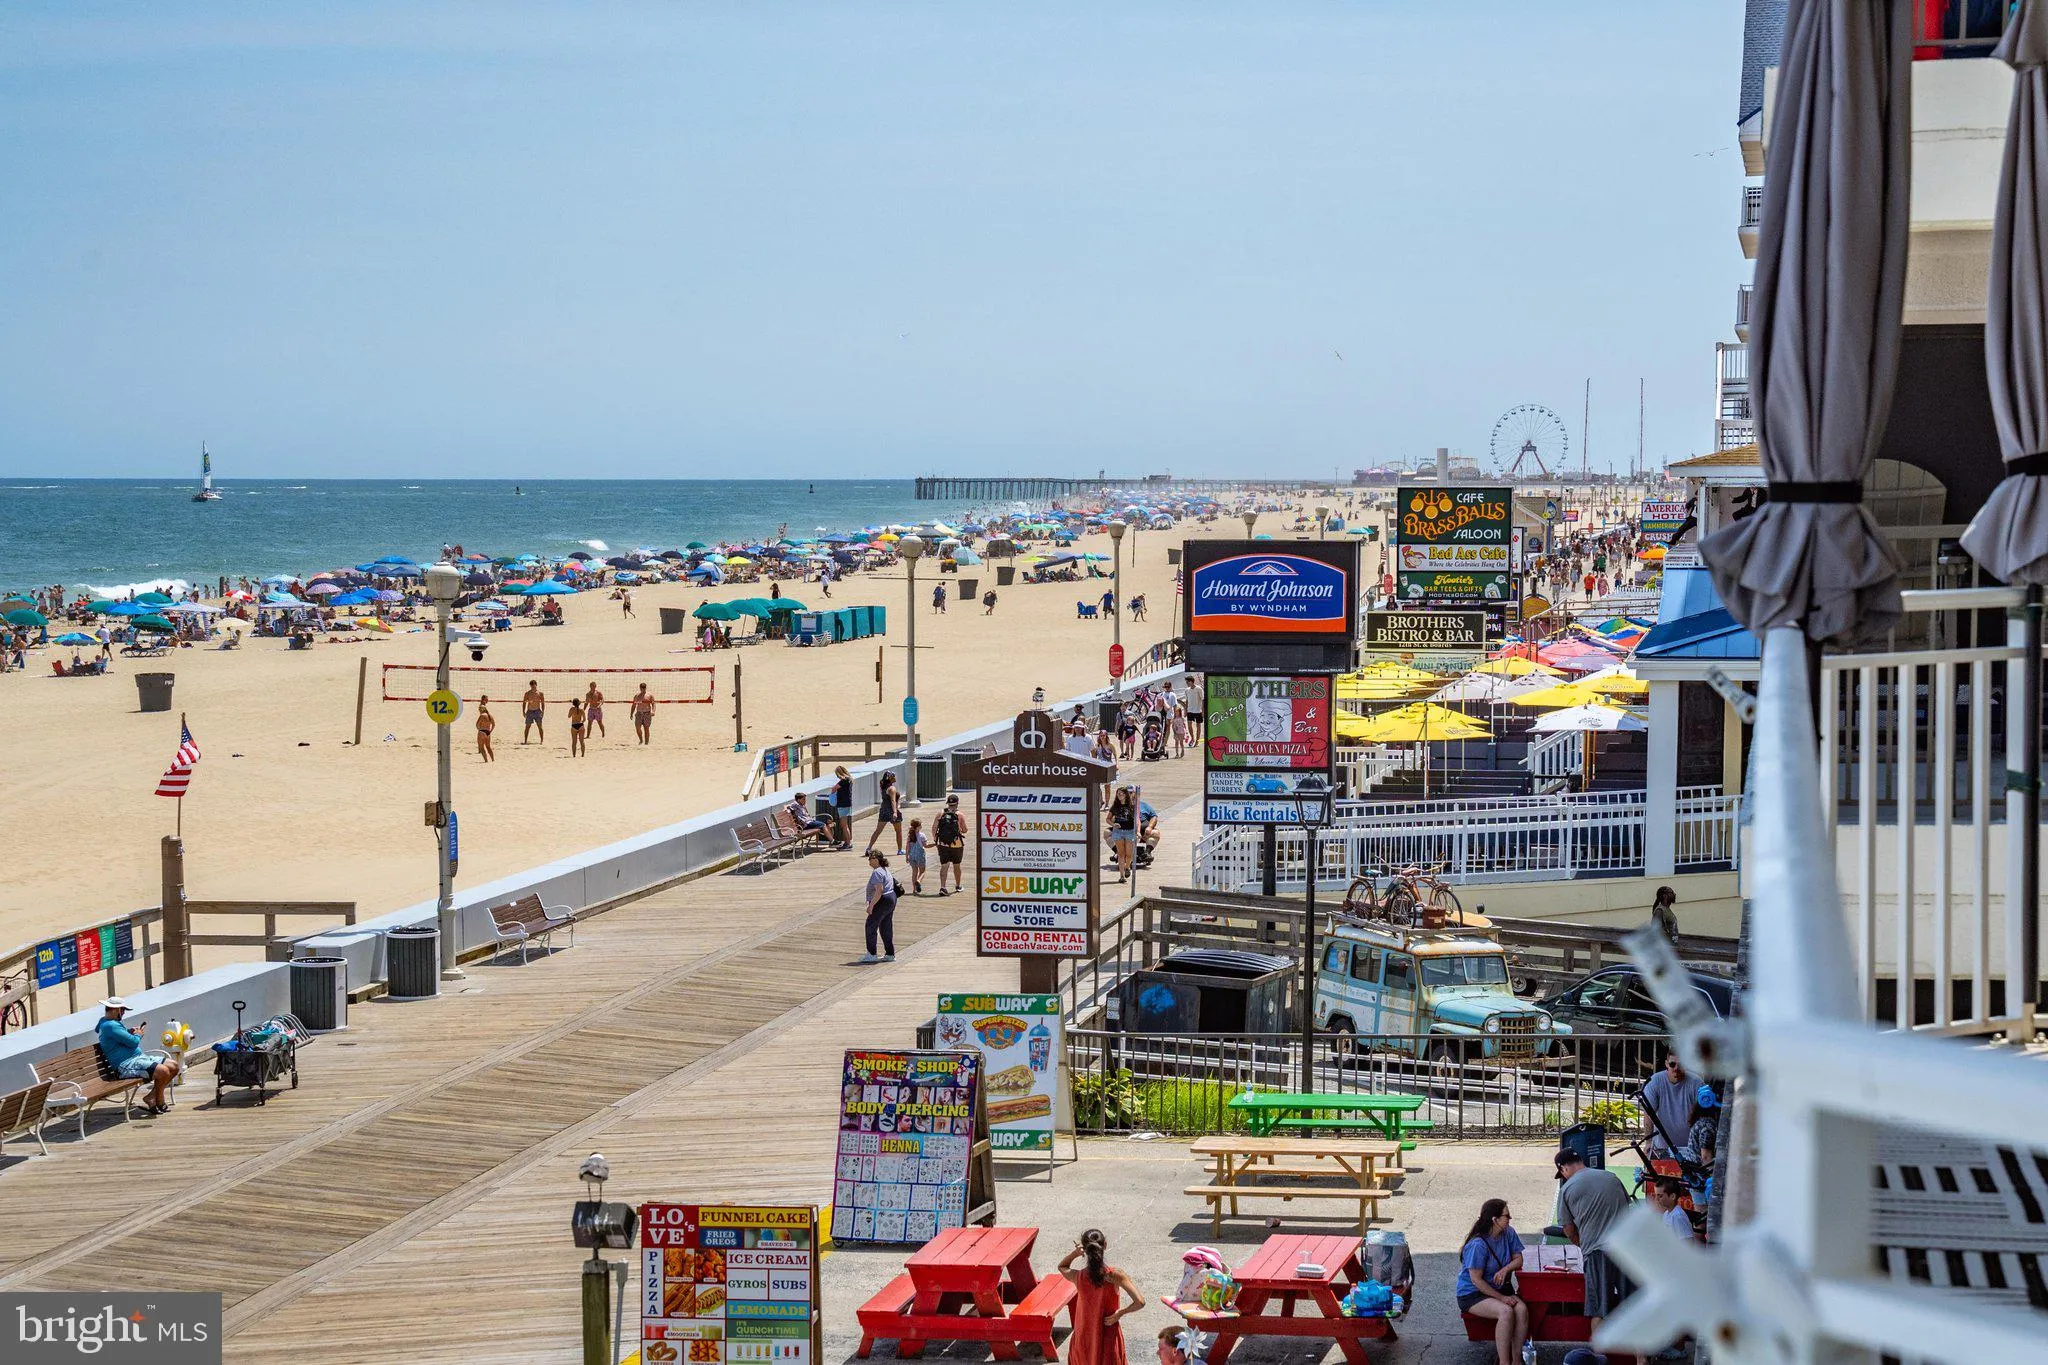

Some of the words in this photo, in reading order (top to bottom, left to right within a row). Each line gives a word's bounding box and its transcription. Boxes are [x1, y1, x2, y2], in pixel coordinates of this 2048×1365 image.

[1456, 493, 1484, 503] CAFE
[1644, 504, 1686, 512] AMERICA
[1404, 512, 1456, 540] BRASS
[1456, 502, 1506, 528] BALLS
[1453, 530, 1501, 539] SALOON
[1429, 547, 1453, 560] Bad
[1455, 547, 1478, 560] Ass
[1480, 547, 1506, 560] Cafe
[1434, 574, 1474, 585] Hootie's
[1202, 580, 1268, 598] Howard
[1266, 580, 1333, 602] Johnson
[1387, 616, 1464, 629] BROTHERS
[1377, 629, 1429, 642] BISTRO
[1432, 630, 1444, 641] &
[1446, 630, 1474, 642] BAR
[1212, 680, 1326, 699] BROTHERS
[1210, 704, 1244, 726] Bistro
[1306, 708, 1316, 719] &
[1294, 721, 1318, 733] Bar
[1228, 743, 1255, 754] BRICK
[1256, 744, 1279, 754] OVEN
[1282, 744, 1307, 754] PIZZA
[982, 762, 1039, 775] decatur
[1042, 764, 1087, 776] house
[986, 793, 1038, 803] Beach
[1040, 794, 1082, 804] Daze
[1209, 806, 1239, 820] Bike
[1244, 806, 1298, 821] Rentals
[1019, 822, 1083, 832] LEMONADE
[1008, 847, 1050, 858] Karsons
[1052, 848, 1077, 860] Keys
[984, 876, 1084, 895] SUBWAY
[991, 903, 1078, 915] CONVENIENCE
[1014, 915, 1054, 926] STORE
[983, 932, 1030, 942] CONDO
[1034, 933, 1085, 944] RENTAL
[986, 942, 1082, 951] OCBeachVacay.com
[962, 997, 1038, 1011] SUBWAY
[852, 1059, 907, 1072] SMOKE
[917, 1061, 959, 1072] SHOP
[846, 1102, 886, 1114] BODY
[895, 1104, 969, 1117] PIERCING
[881, 1139, 920, 1153] HENNA
[701, 1212, 764, 1222] FUNNEL
[766, 1213, 808, 1223] CAKE
[729, 1254, 753, 1264] ICE
[756, 1255, 808, 1264] CREAM
[728, 1280, 767, 1289] GYROS
[772, 1280, 807, 1289] SUBS
[729, 1305, 807, 1315] LEMONADE
